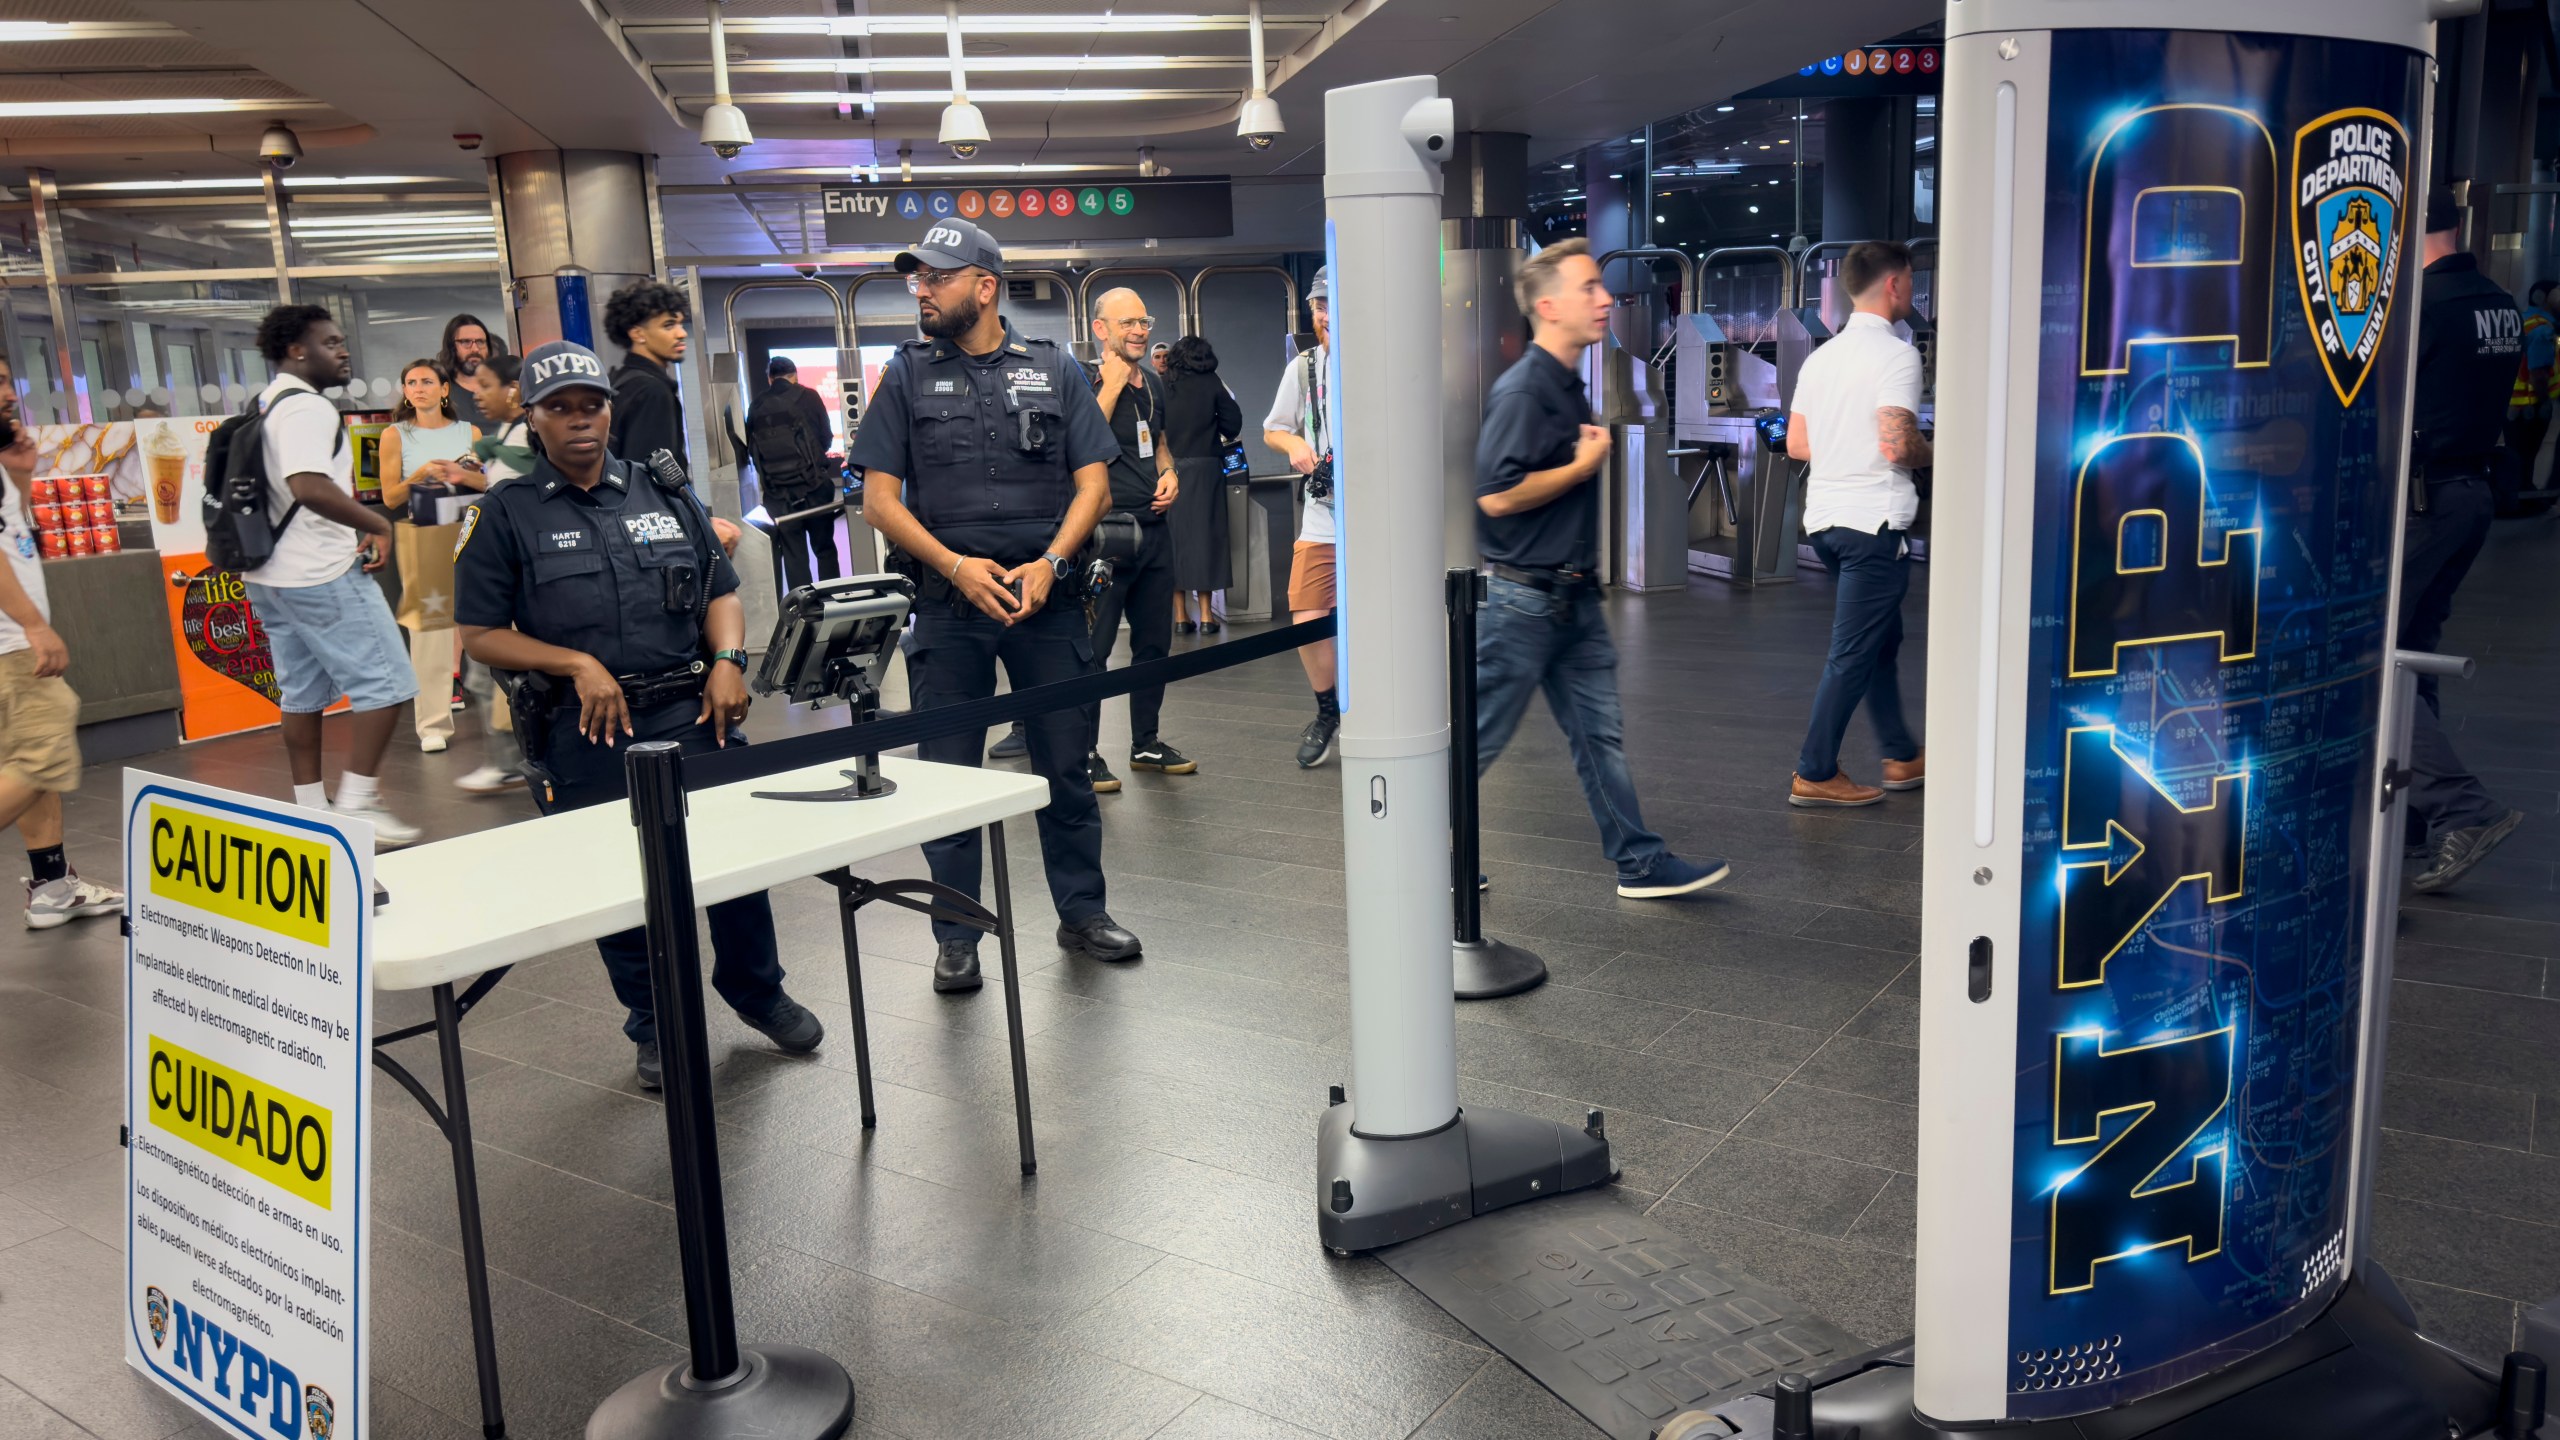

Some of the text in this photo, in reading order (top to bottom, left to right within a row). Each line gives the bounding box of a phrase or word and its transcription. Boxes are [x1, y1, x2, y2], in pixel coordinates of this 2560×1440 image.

[1850, 54, 1860, 70] J
[1874, 54, 1886, 69] Z
[1899, 53, 1910, 69] 2
[1923, 52, 1934, 68] 3
[2330, 124, 2392, 161] POLICE
[2302, 155, 2403, 208] DEPARTMENT
[825, 191, 1127, 217] Entry A C J Z 2 3 4 5
[2303, 239, 2340, 354] CITY OF
[2356, 232, 2400, 363] NEW YORK
[2474, 309, 2522, 339] NYPD
[531, 352, 600, 385] NYPD
[1006, 372, 1049, 381] POLICE
[2190, 389, 2310, 422] Manhattan
[551, 531, 581, 541] HARTE
[625, 516, 681, 533] POLICE
[557, 540, 577, 548] 6218
[204, 570, 246, 605] life
[184, 618, 204, 634] life
[210, 619, 248, 640] best
[191, 639, 207, 653] life
[2050, 103, 2279, 1297] NYPD
[152, 817, 326, 925] CAUTION
[141, 904, 342, 986] Electromagnetic Weapons Detection In Use.
[135, 948, 350, 1042] Implantable electronic medical devices may be
[2153, 991, 2199, 1023] Christopher
[152, 988, 326, 1070] affected by electromagnetic radiation.
[150, 1050, 328, 1182] CUIDADO
[138, 1134, 344, 1254] Electromagnético detección de armas en uso.
[136, 1178, 346, 1305] Los dispositivos médicos electrónicos implant-
[137, 1213, 344, 1342] ables pueden verse afectados por la radiación
[192, 1277, 274, 1338] electromagnético.
[173, 1298, 302, 1440] NYPD
